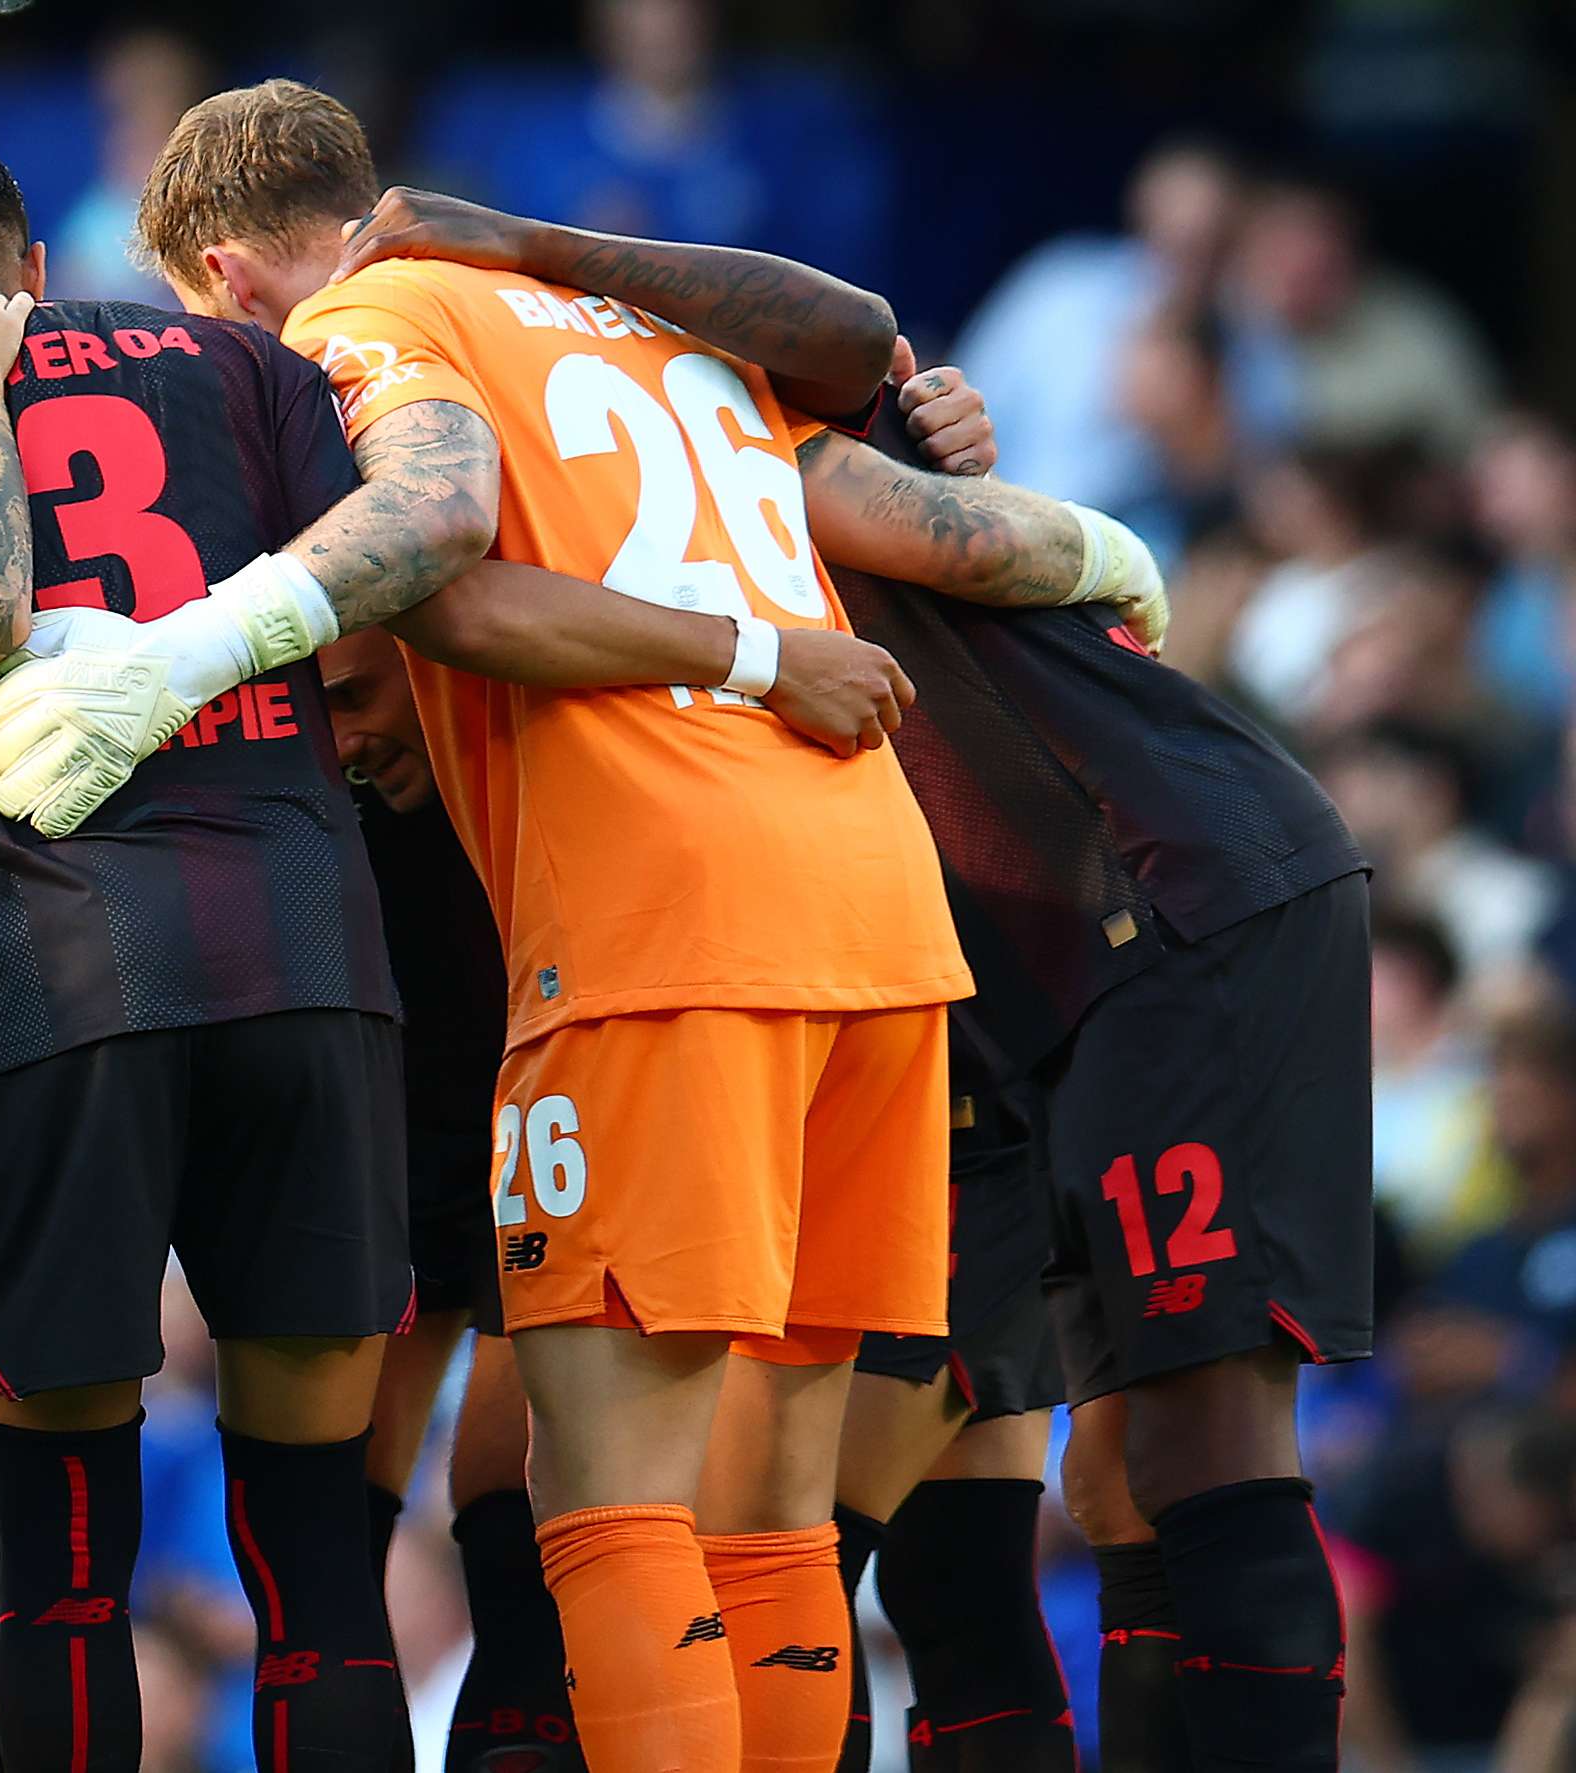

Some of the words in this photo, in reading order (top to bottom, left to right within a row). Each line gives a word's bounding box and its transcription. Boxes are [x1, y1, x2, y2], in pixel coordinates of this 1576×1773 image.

[18, 393, 209, 624] 3
[544, 353, 826, 620] 26
[157, 682, 300, 751] APIE
[493, 1094, 588, 1228] 26
[1100, 1142, 1238, 1277] 12
